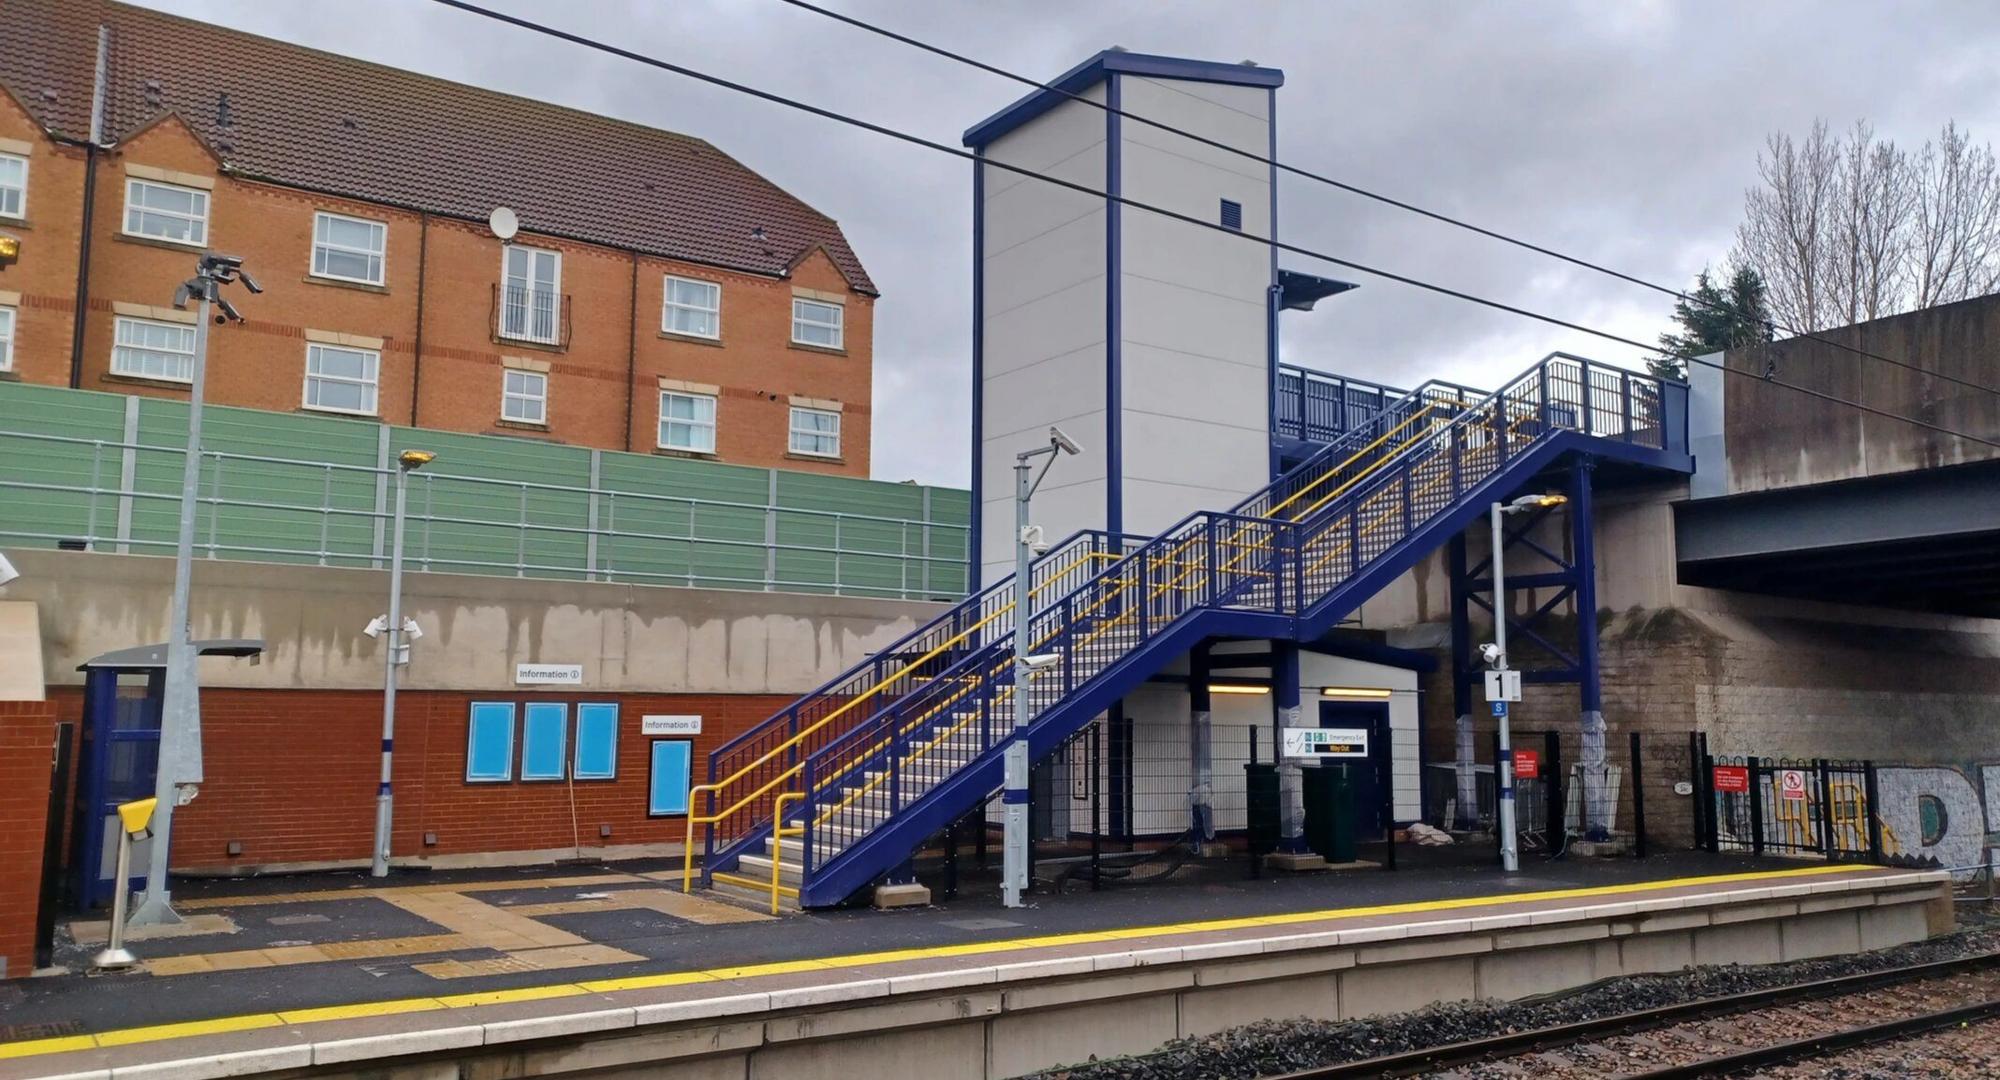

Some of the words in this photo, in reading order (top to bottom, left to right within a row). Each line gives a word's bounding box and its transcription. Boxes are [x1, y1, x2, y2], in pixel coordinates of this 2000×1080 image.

[519, 669, 568, 679] Information
[1495, 673, 1503, 698] 1
[645, 720, 689, 729] Information
